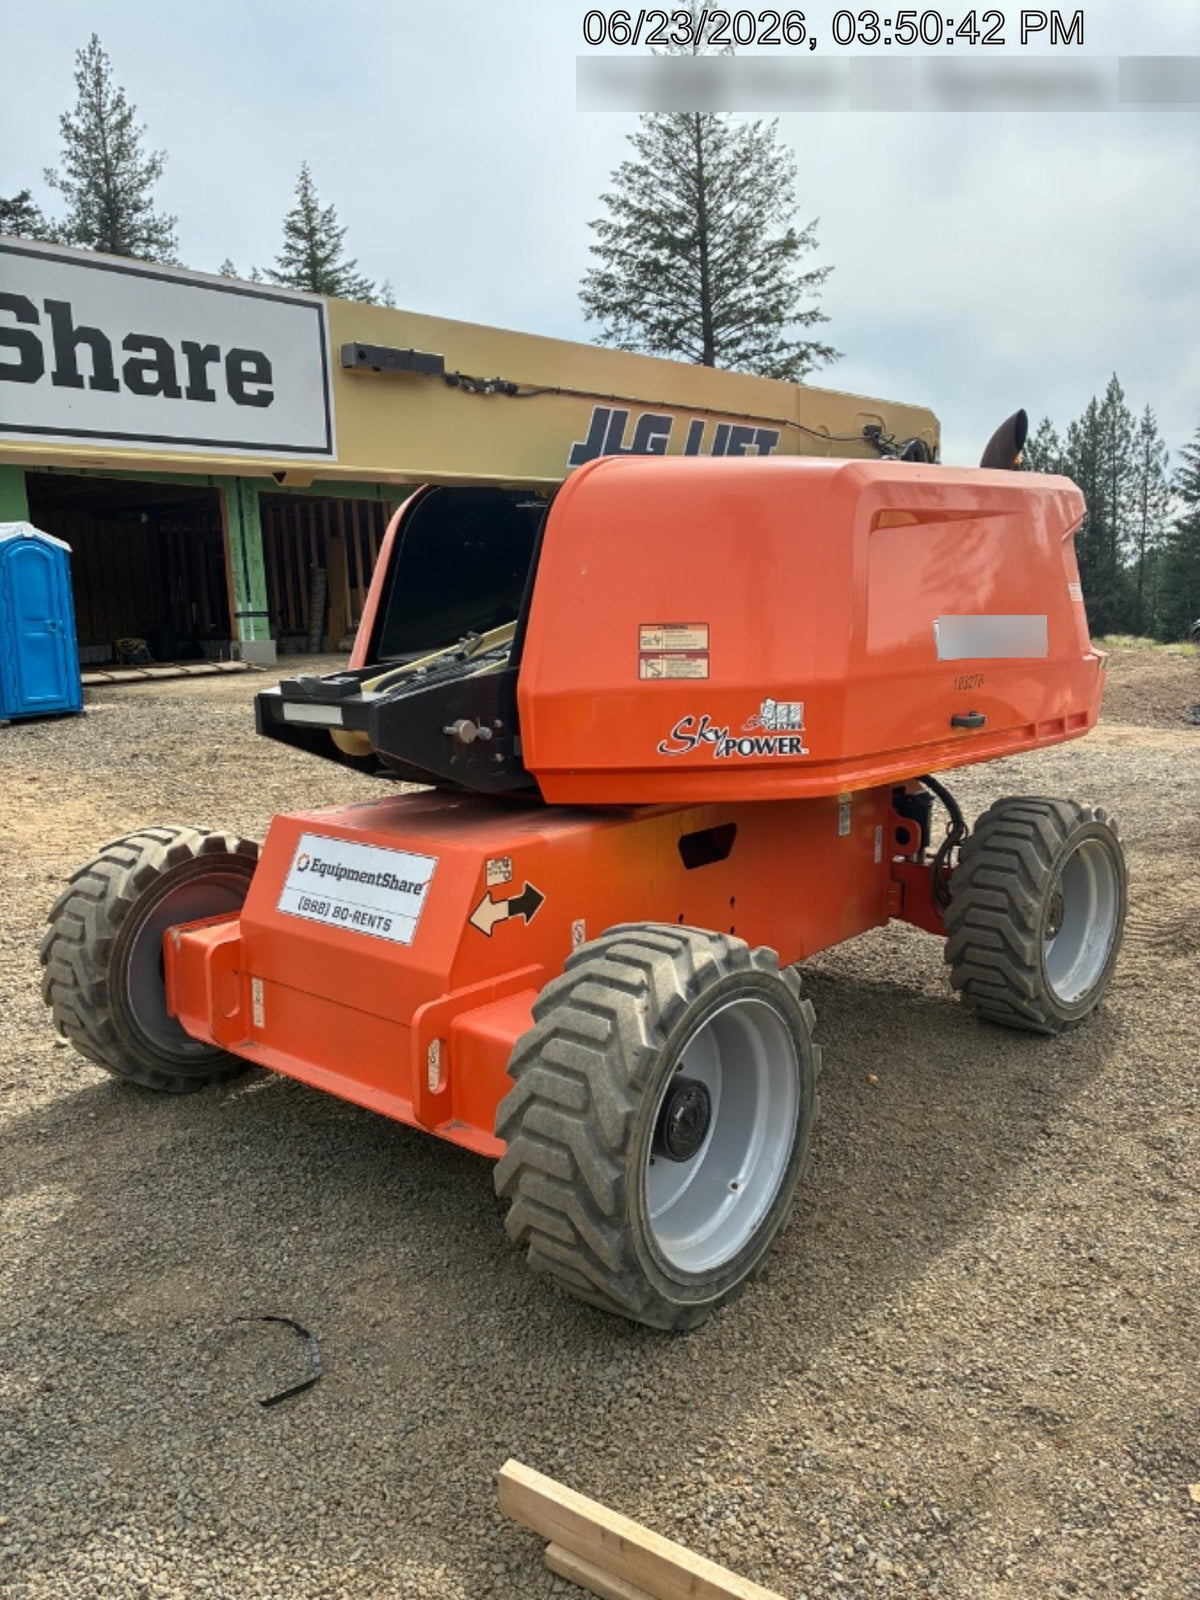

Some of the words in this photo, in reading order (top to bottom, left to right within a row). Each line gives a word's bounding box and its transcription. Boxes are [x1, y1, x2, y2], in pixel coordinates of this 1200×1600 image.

[567, 405, 674, 468] JLG
[310, 858, 423, 896] EquipmentShare
[298, 896, 331, 918] (888)
[332, 905, 393, 932] 80-RENTS
